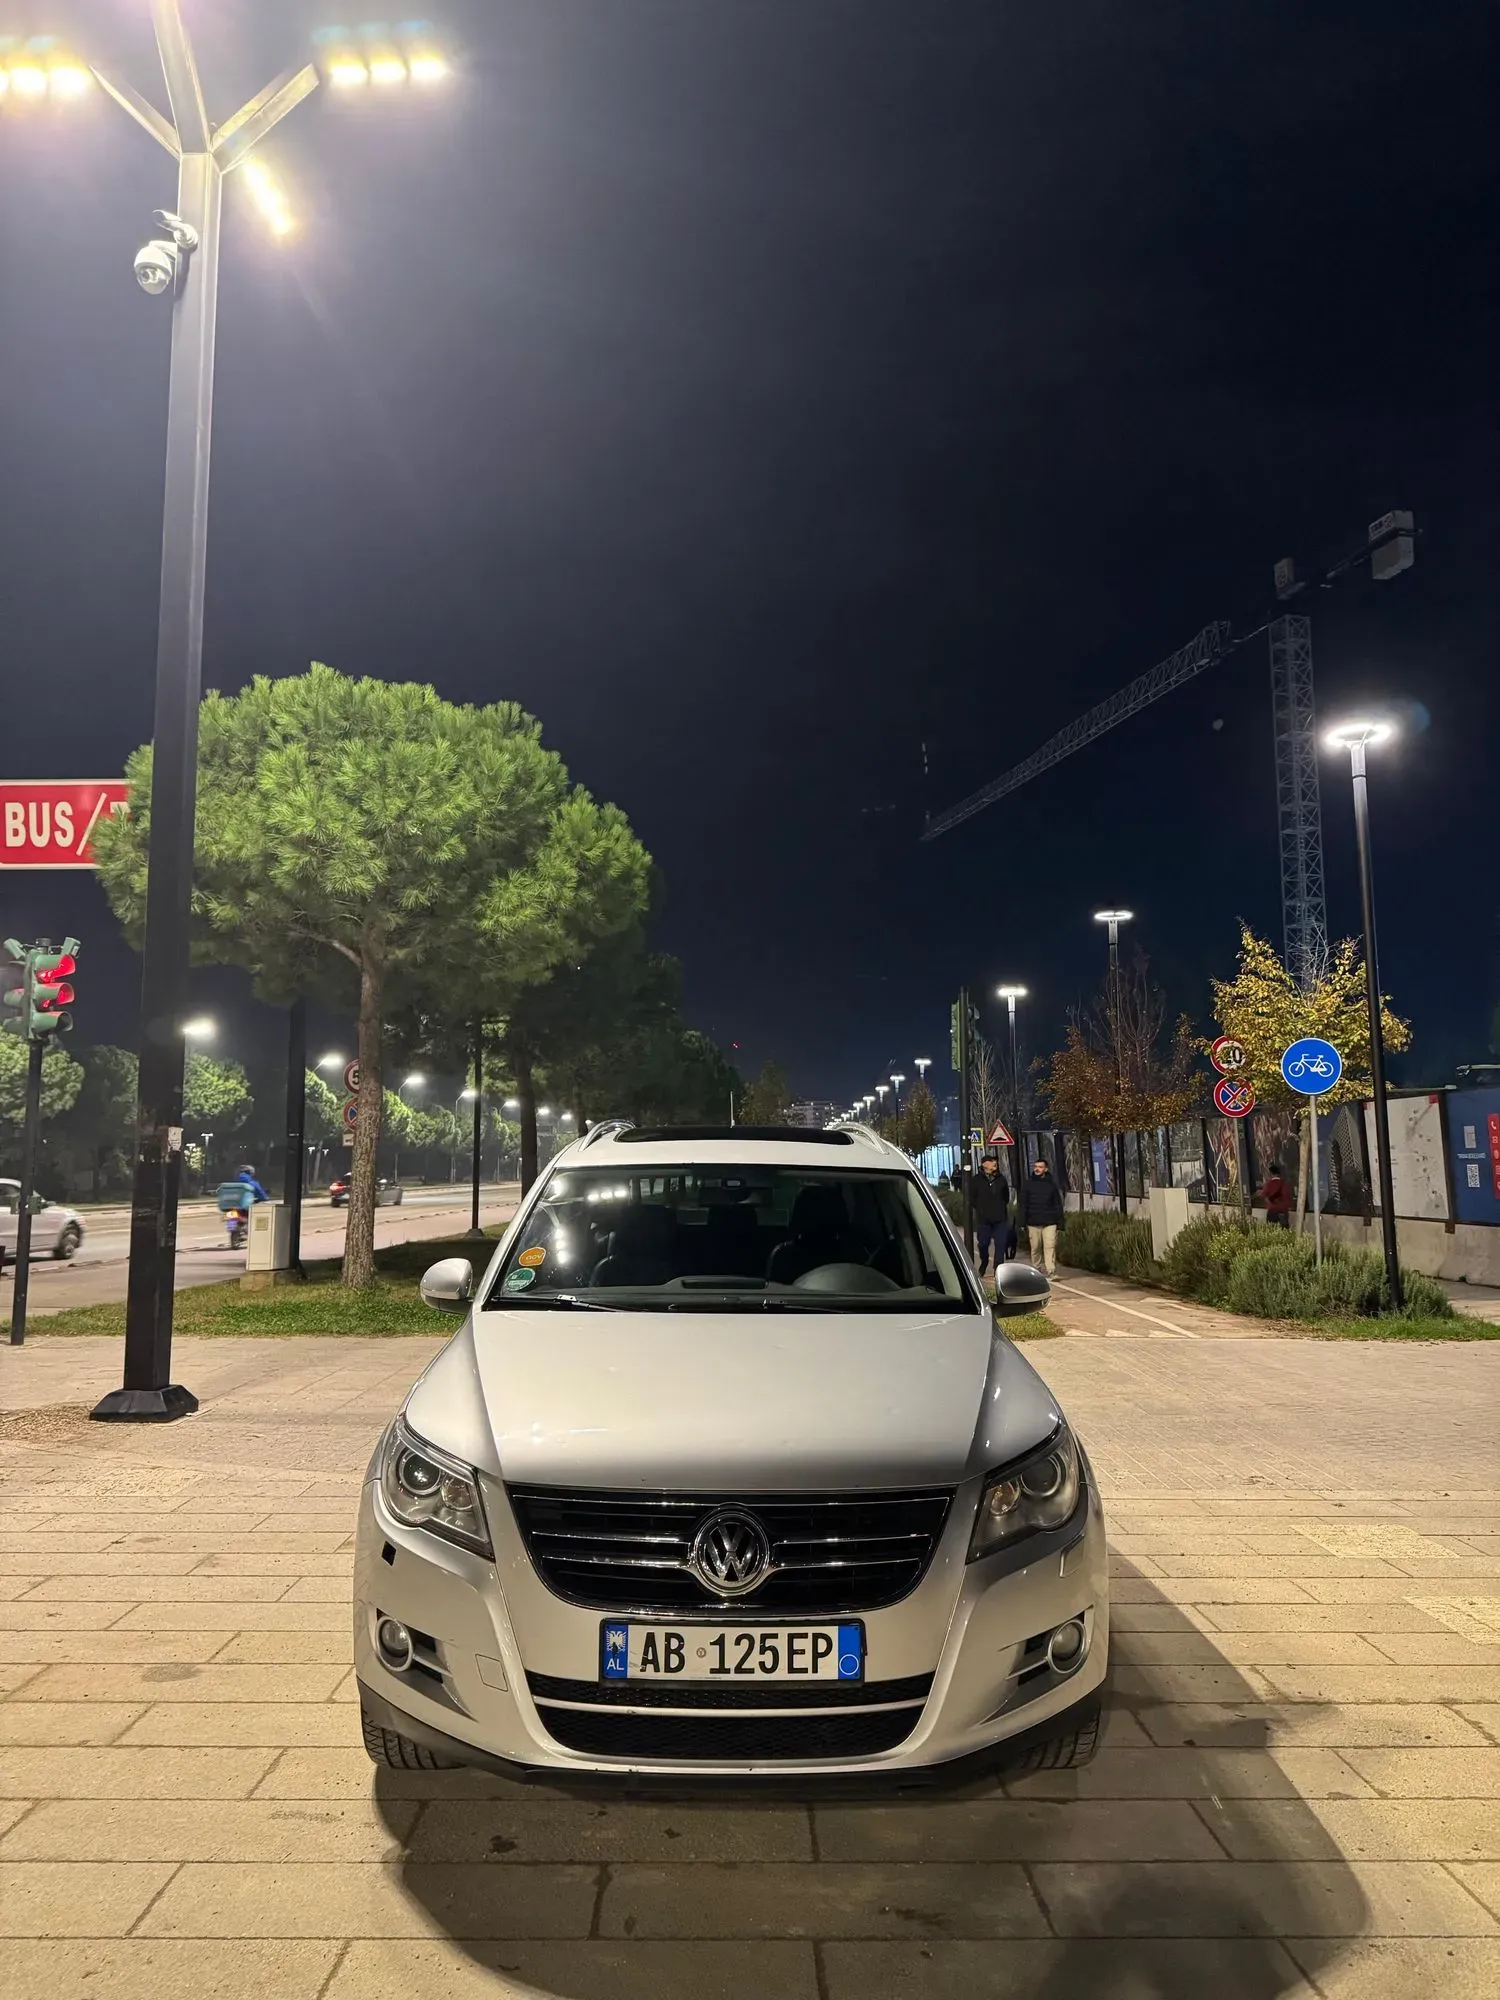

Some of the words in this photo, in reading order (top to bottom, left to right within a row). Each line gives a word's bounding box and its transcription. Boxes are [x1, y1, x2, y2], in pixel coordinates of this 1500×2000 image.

[702, 1519, 760, 1584] VW
[606, 1658, 625, 1671] AL
[640, 1632, 685, 1673] AB
[709, 1632, 834, 1675] 125EP
